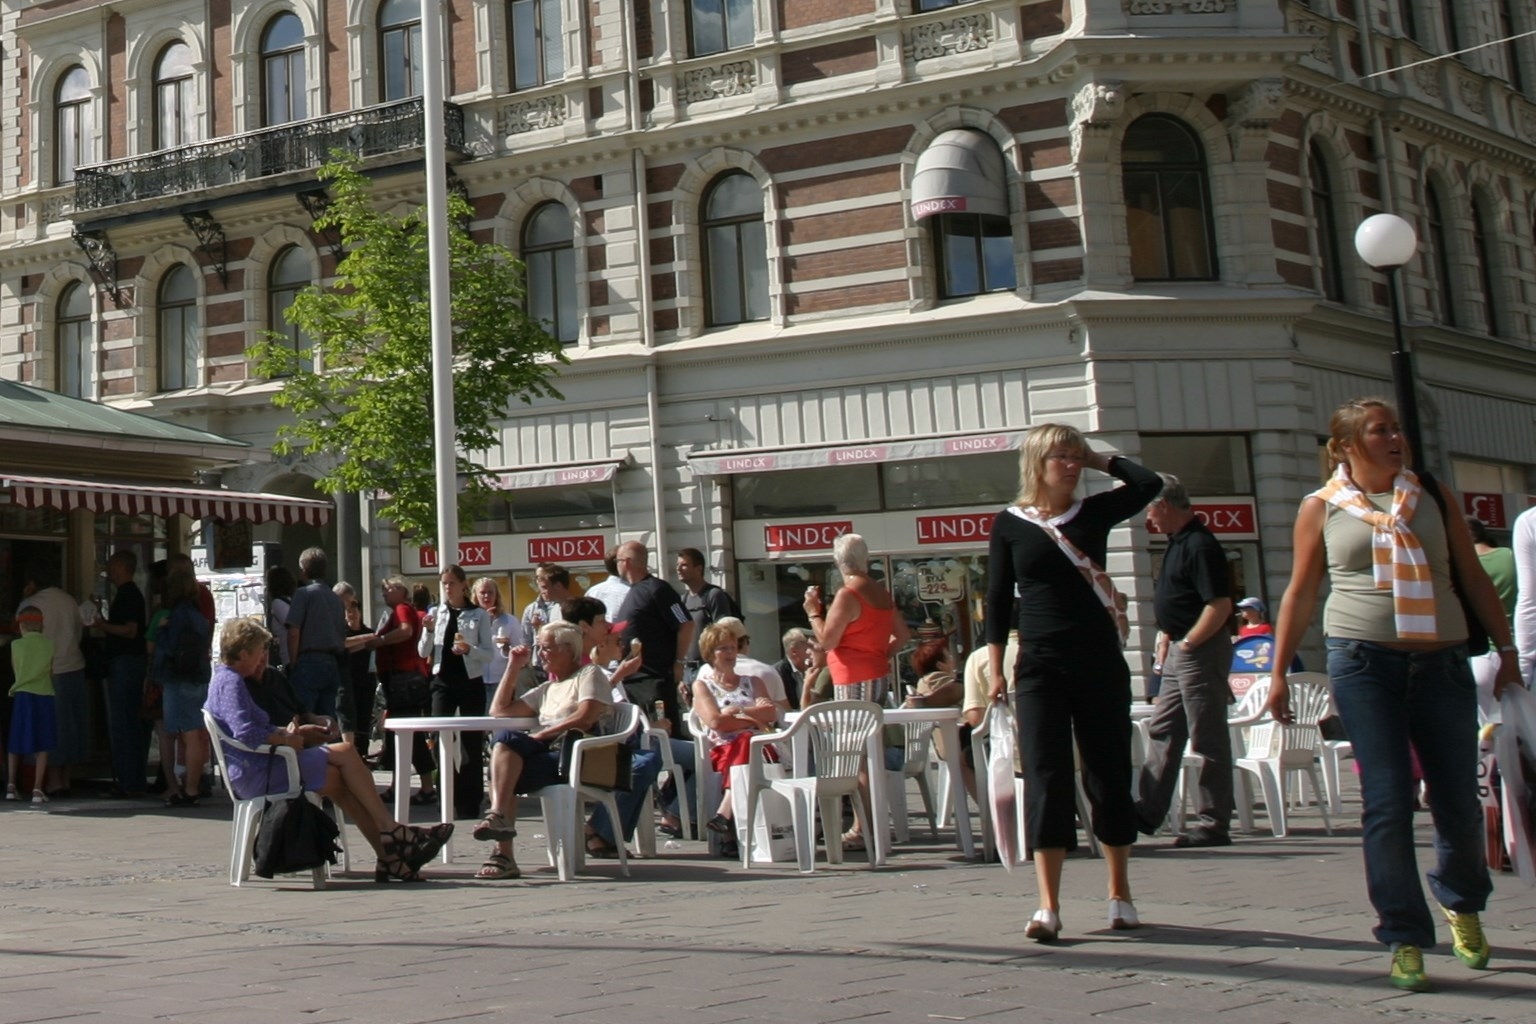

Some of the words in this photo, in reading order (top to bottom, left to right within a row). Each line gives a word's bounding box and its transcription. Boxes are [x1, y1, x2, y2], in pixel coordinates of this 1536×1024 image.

[915, 199, 959, 215] LINDEX
[952, 437, 998, 451] LINDEX
[836, 448, 878, 461] LINDEX
[726, 457, 765, 470] LINDEX
[562, 469, 598, 481] LINDEX
[1194, 510, 1243, 528] DEX
[918, 518, 992, 539] LINDE
[425, 546, 486, 566] LIDEX
[530, 538, 601, 559] LINDEX
